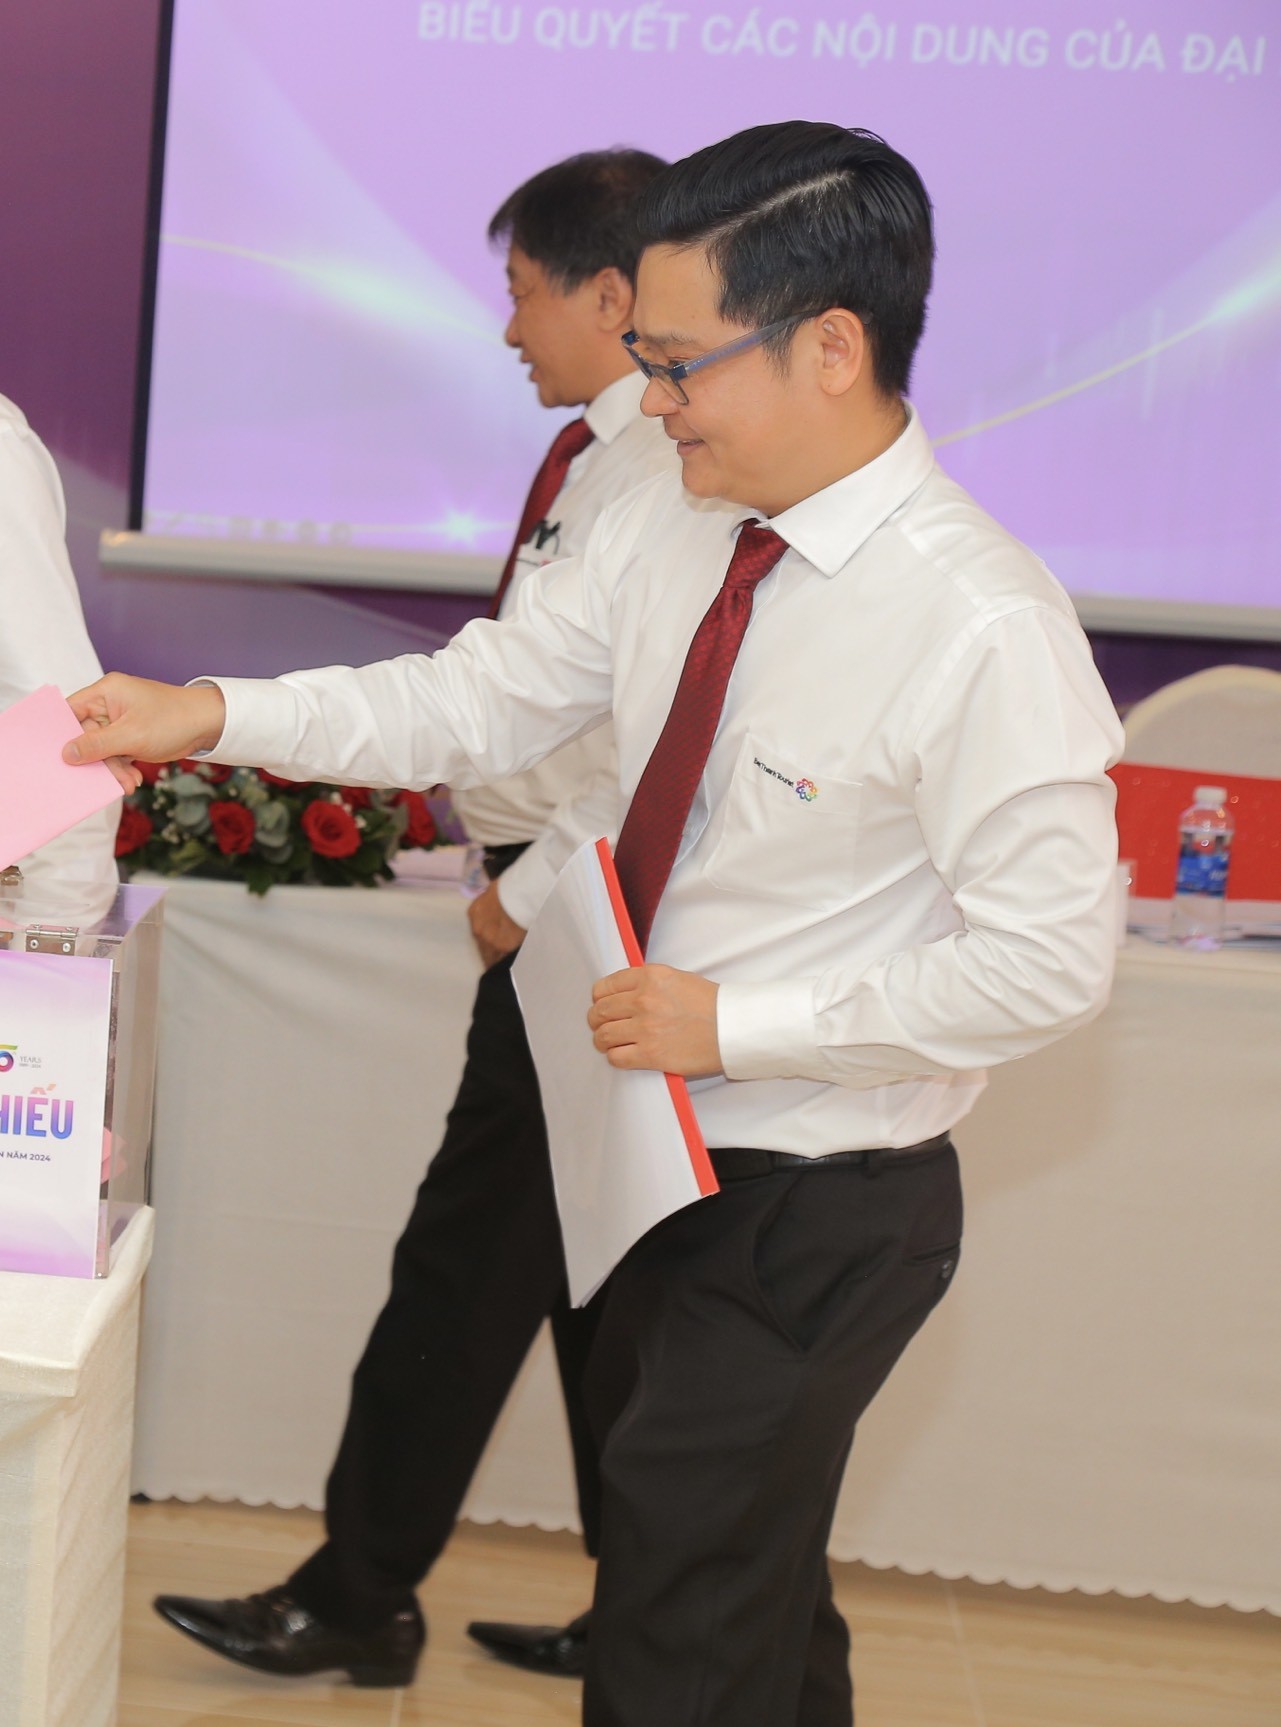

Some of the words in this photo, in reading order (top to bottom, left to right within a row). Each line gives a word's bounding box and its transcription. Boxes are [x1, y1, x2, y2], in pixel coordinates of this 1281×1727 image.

[534, 0, 690, 52] QUYẾT
[701, 7, 801, 58] CÁC
[812, 11, 898, 69] NỘI
[911, 22, 1051, 69] DUNG
[1064, 18, 1166, 73] CỦA
[1180, 32, 1268, 83] ĐẠI
[6, 1150, 28, 1160] NĂM
[29, 1153, 51, 1162] 2024
